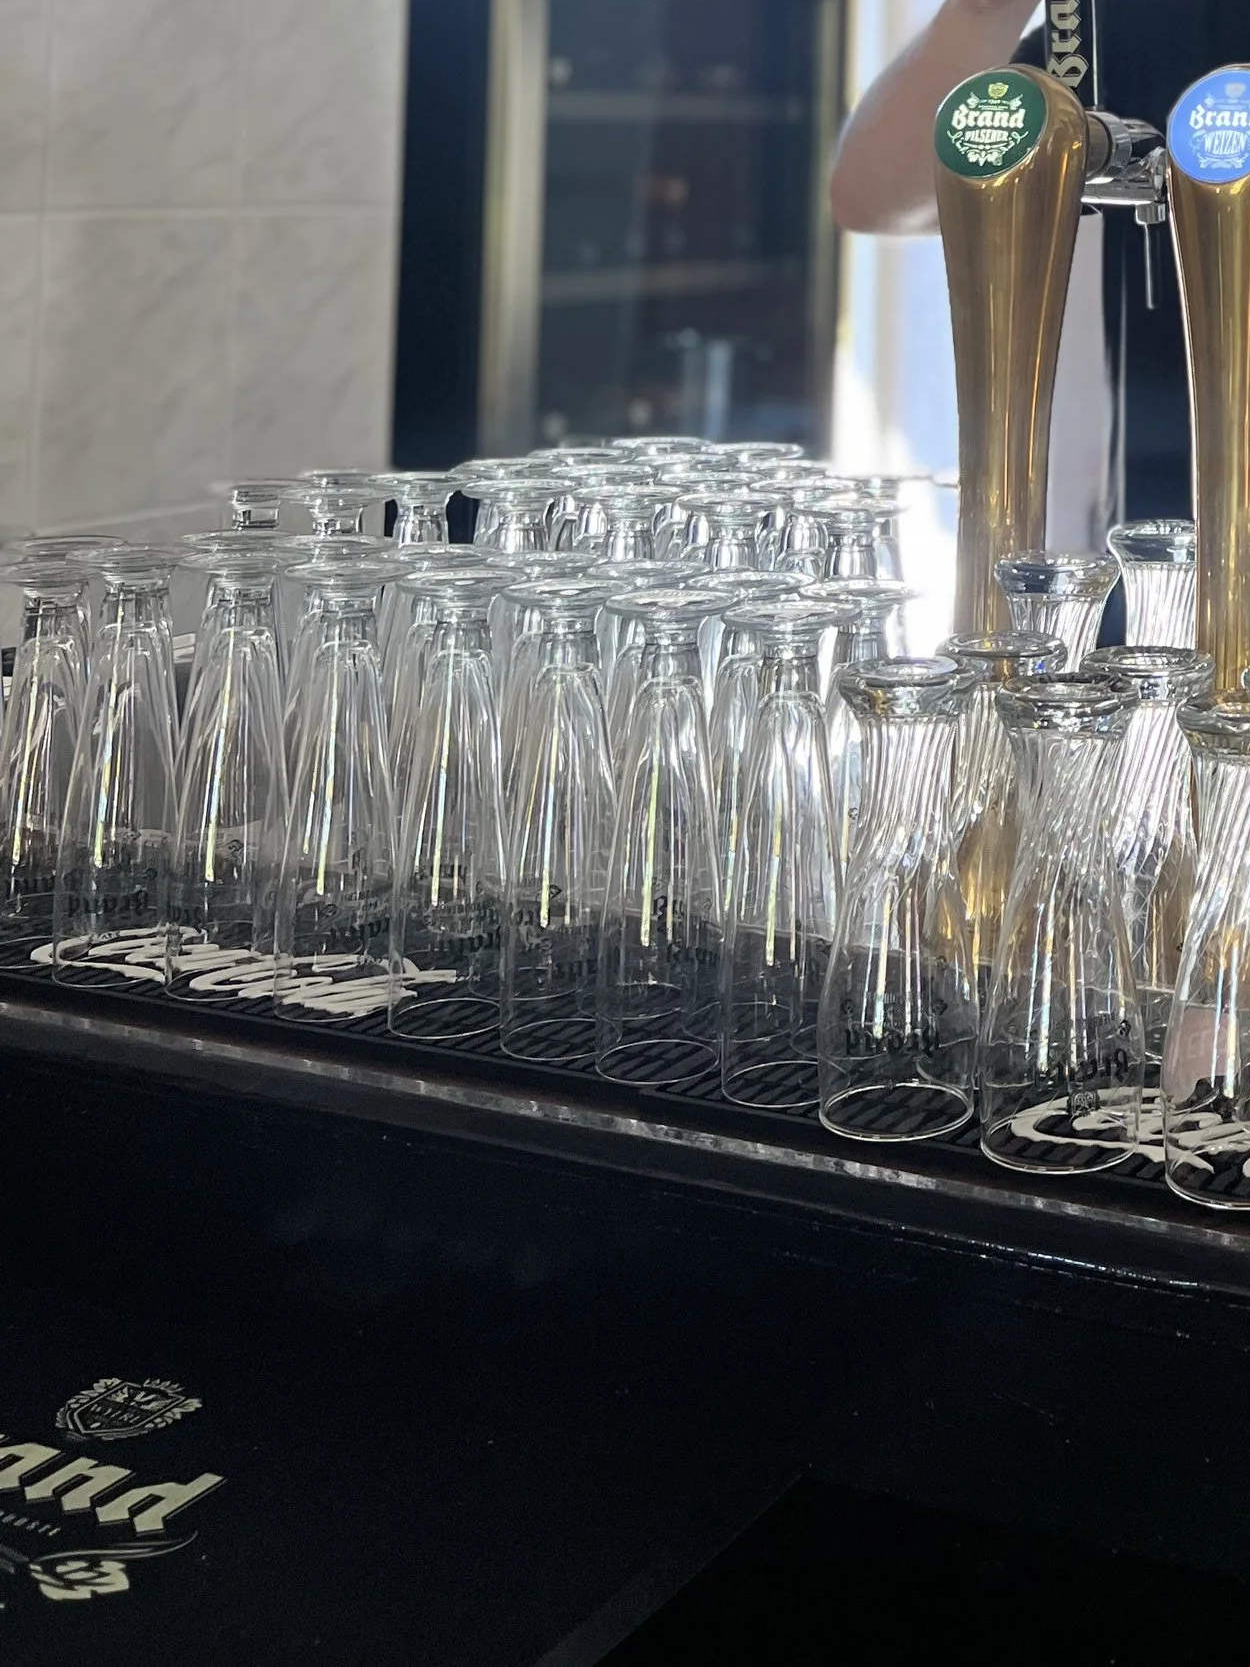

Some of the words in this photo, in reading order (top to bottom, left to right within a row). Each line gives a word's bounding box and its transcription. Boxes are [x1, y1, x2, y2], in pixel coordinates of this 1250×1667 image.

[951, 103, 1026, 130] Brand
[964, 129, 1009, 143] PILSENER
[1204, 130, 1248, 155] WEIZEN
[0, 1441, 228, 1537] and
